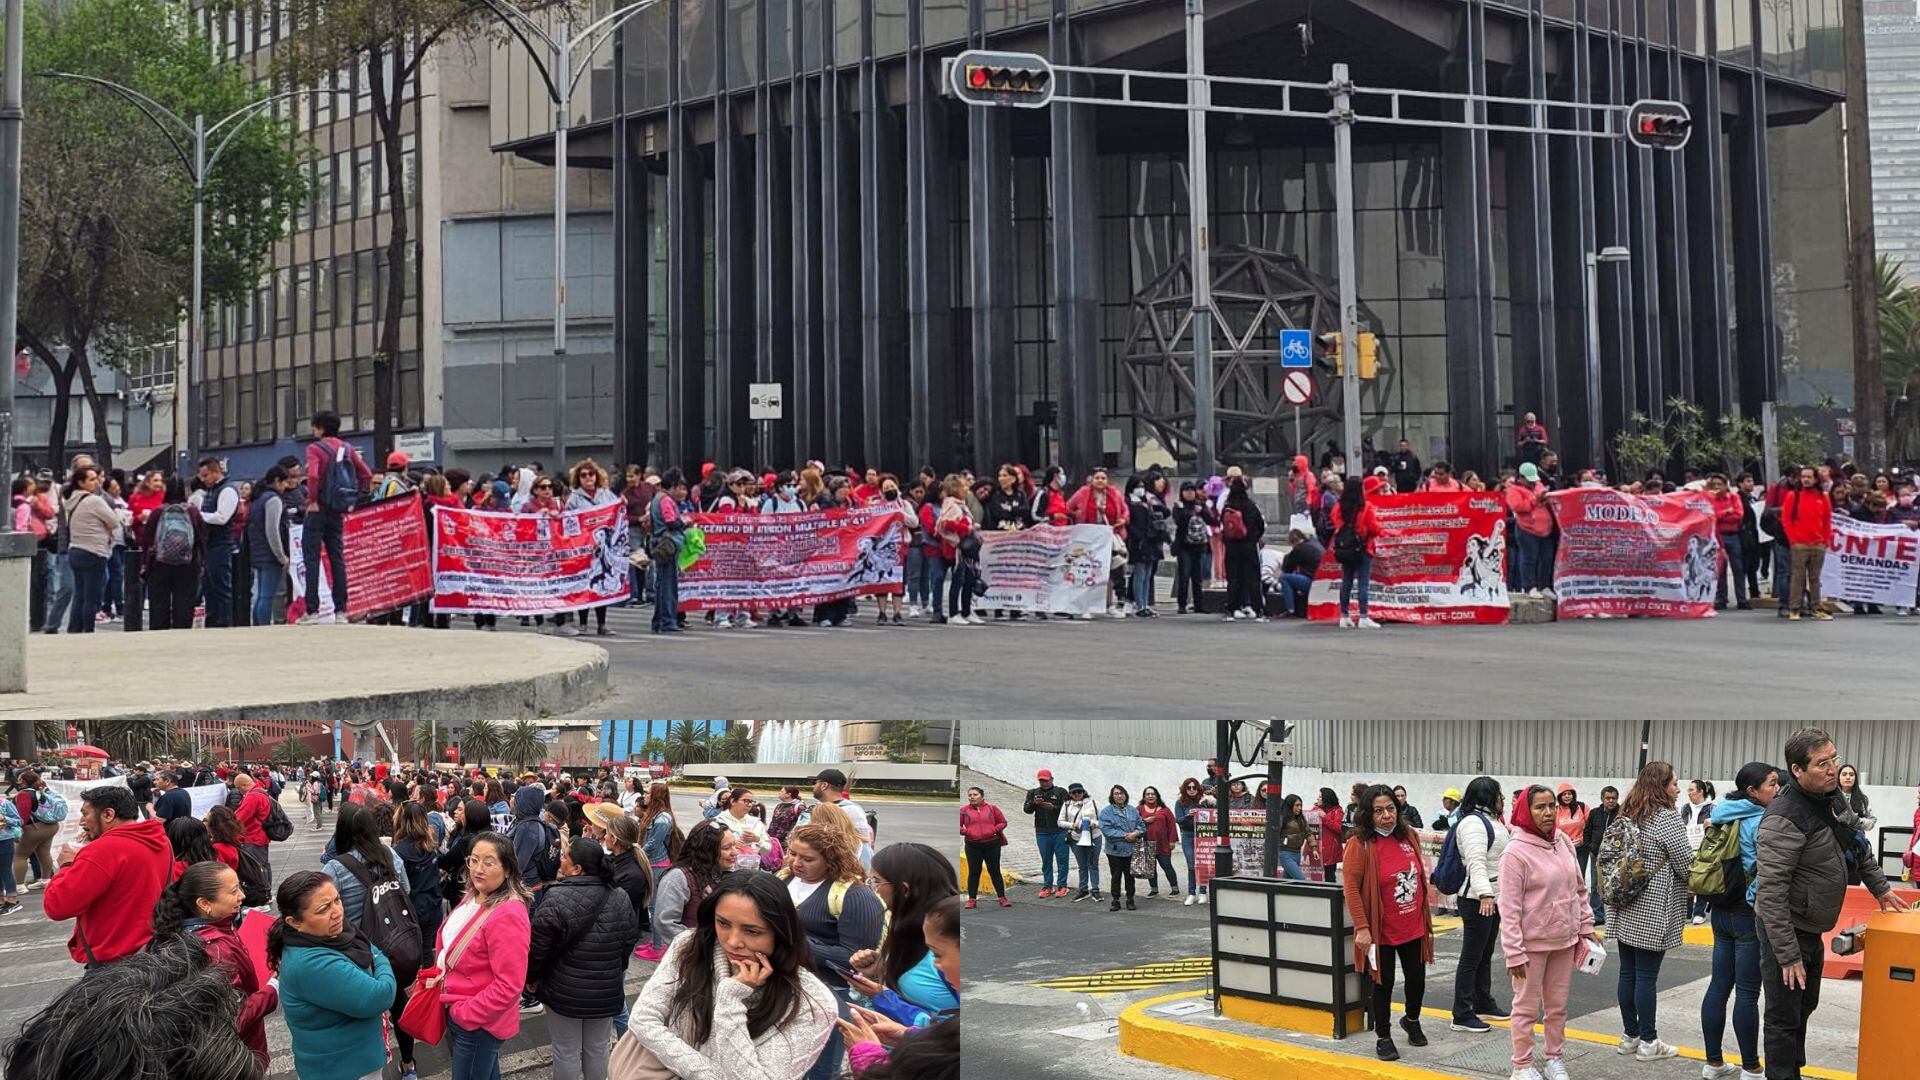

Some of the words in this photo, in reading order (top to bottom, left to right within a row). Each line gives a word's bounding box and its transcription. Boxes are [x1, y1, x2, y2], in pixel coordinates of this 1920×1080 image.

[1830, 528, 1918, 562] CNTE
[1841, 555, 1910, 571] DEMANDAS
[380, 880, 400, 895] asics
